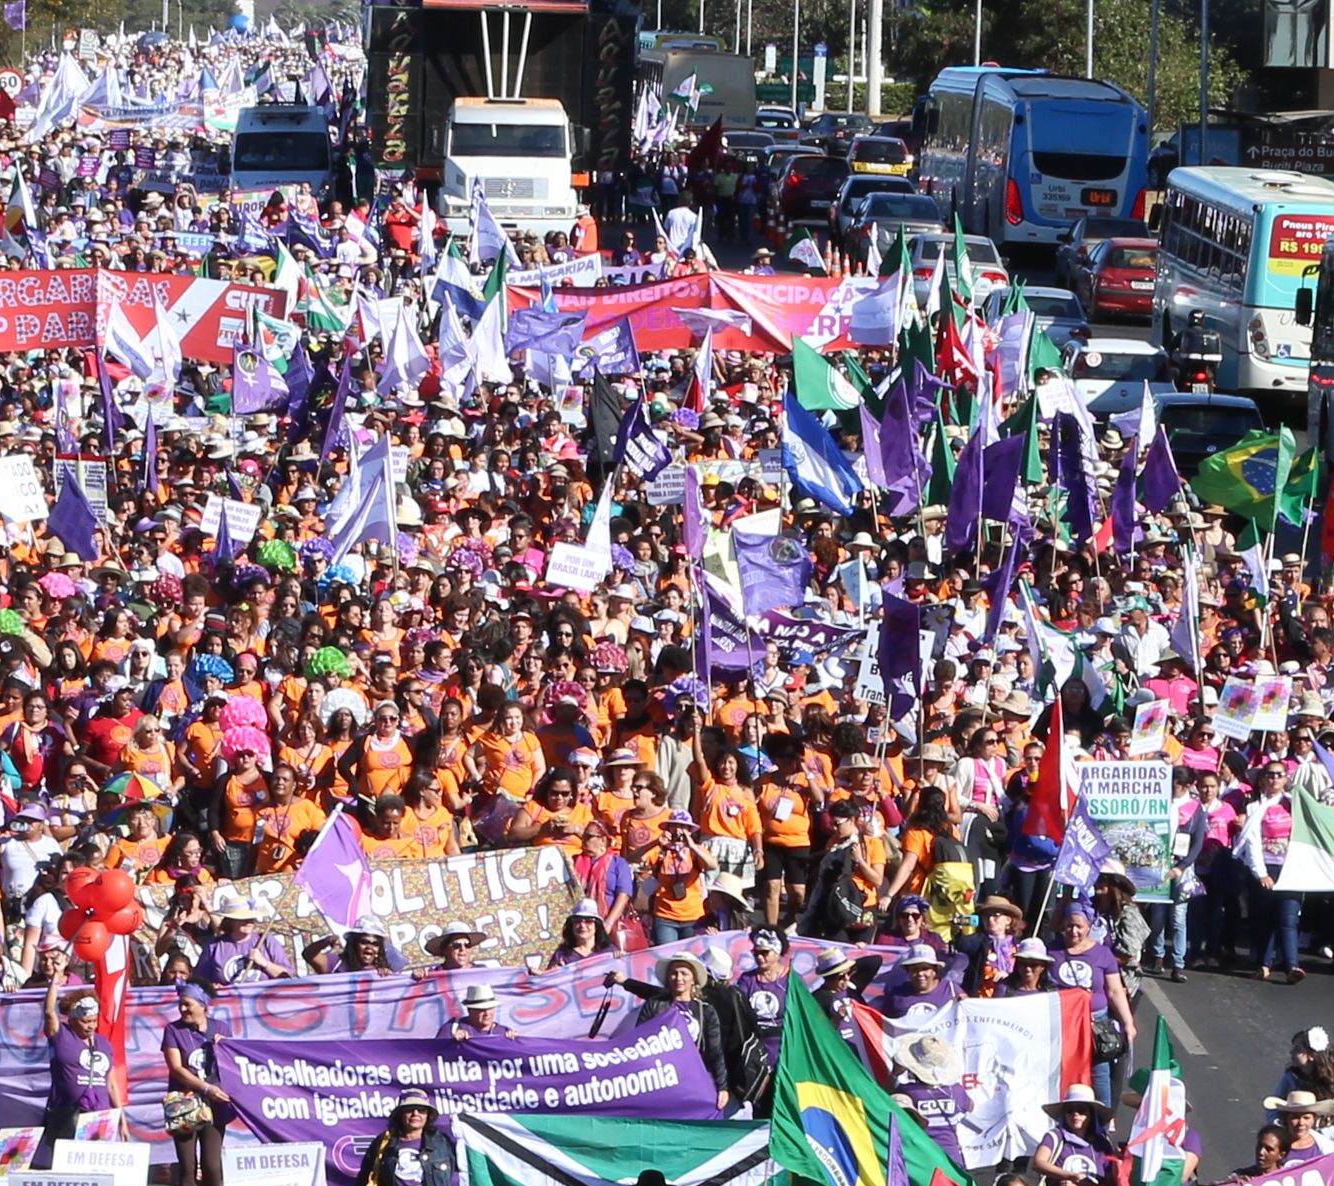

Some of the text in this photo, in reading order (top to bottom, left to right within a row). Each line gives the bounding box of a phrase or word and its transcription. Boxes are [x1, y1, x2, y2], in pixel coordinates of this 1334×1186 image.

[1261, 145, 1294, 158] Praça
[1298, 146, 1314, 157] do
[1294, 160, 1325, 172] Plaza
[1282, 220, 1314, 230] Pneus
[1295, 231, 1313, 239] aro
[1279, 241, 1297, 253] R$
[225, 290, 270, 308] CUT
[1080, 766, 1167, 780] ARGARIDAS
[1083, 781, 1162, 795] M MARCHA
[1089, 797, 1168, 816] SSORÓ/RN
[370, 845, 568, 917] OLITICA
[235, 1028, 684, 1089] Trabalhadoras em luta por uma sociedade
[262, 1065, 679, 1126] com igualda liberdade e autonomia
[919, 1100, 950, 1112] CUT
[67, 1152, 135, 1167] EM DEFESA
[236, 1153, 310, 1170] EM DEFESA
